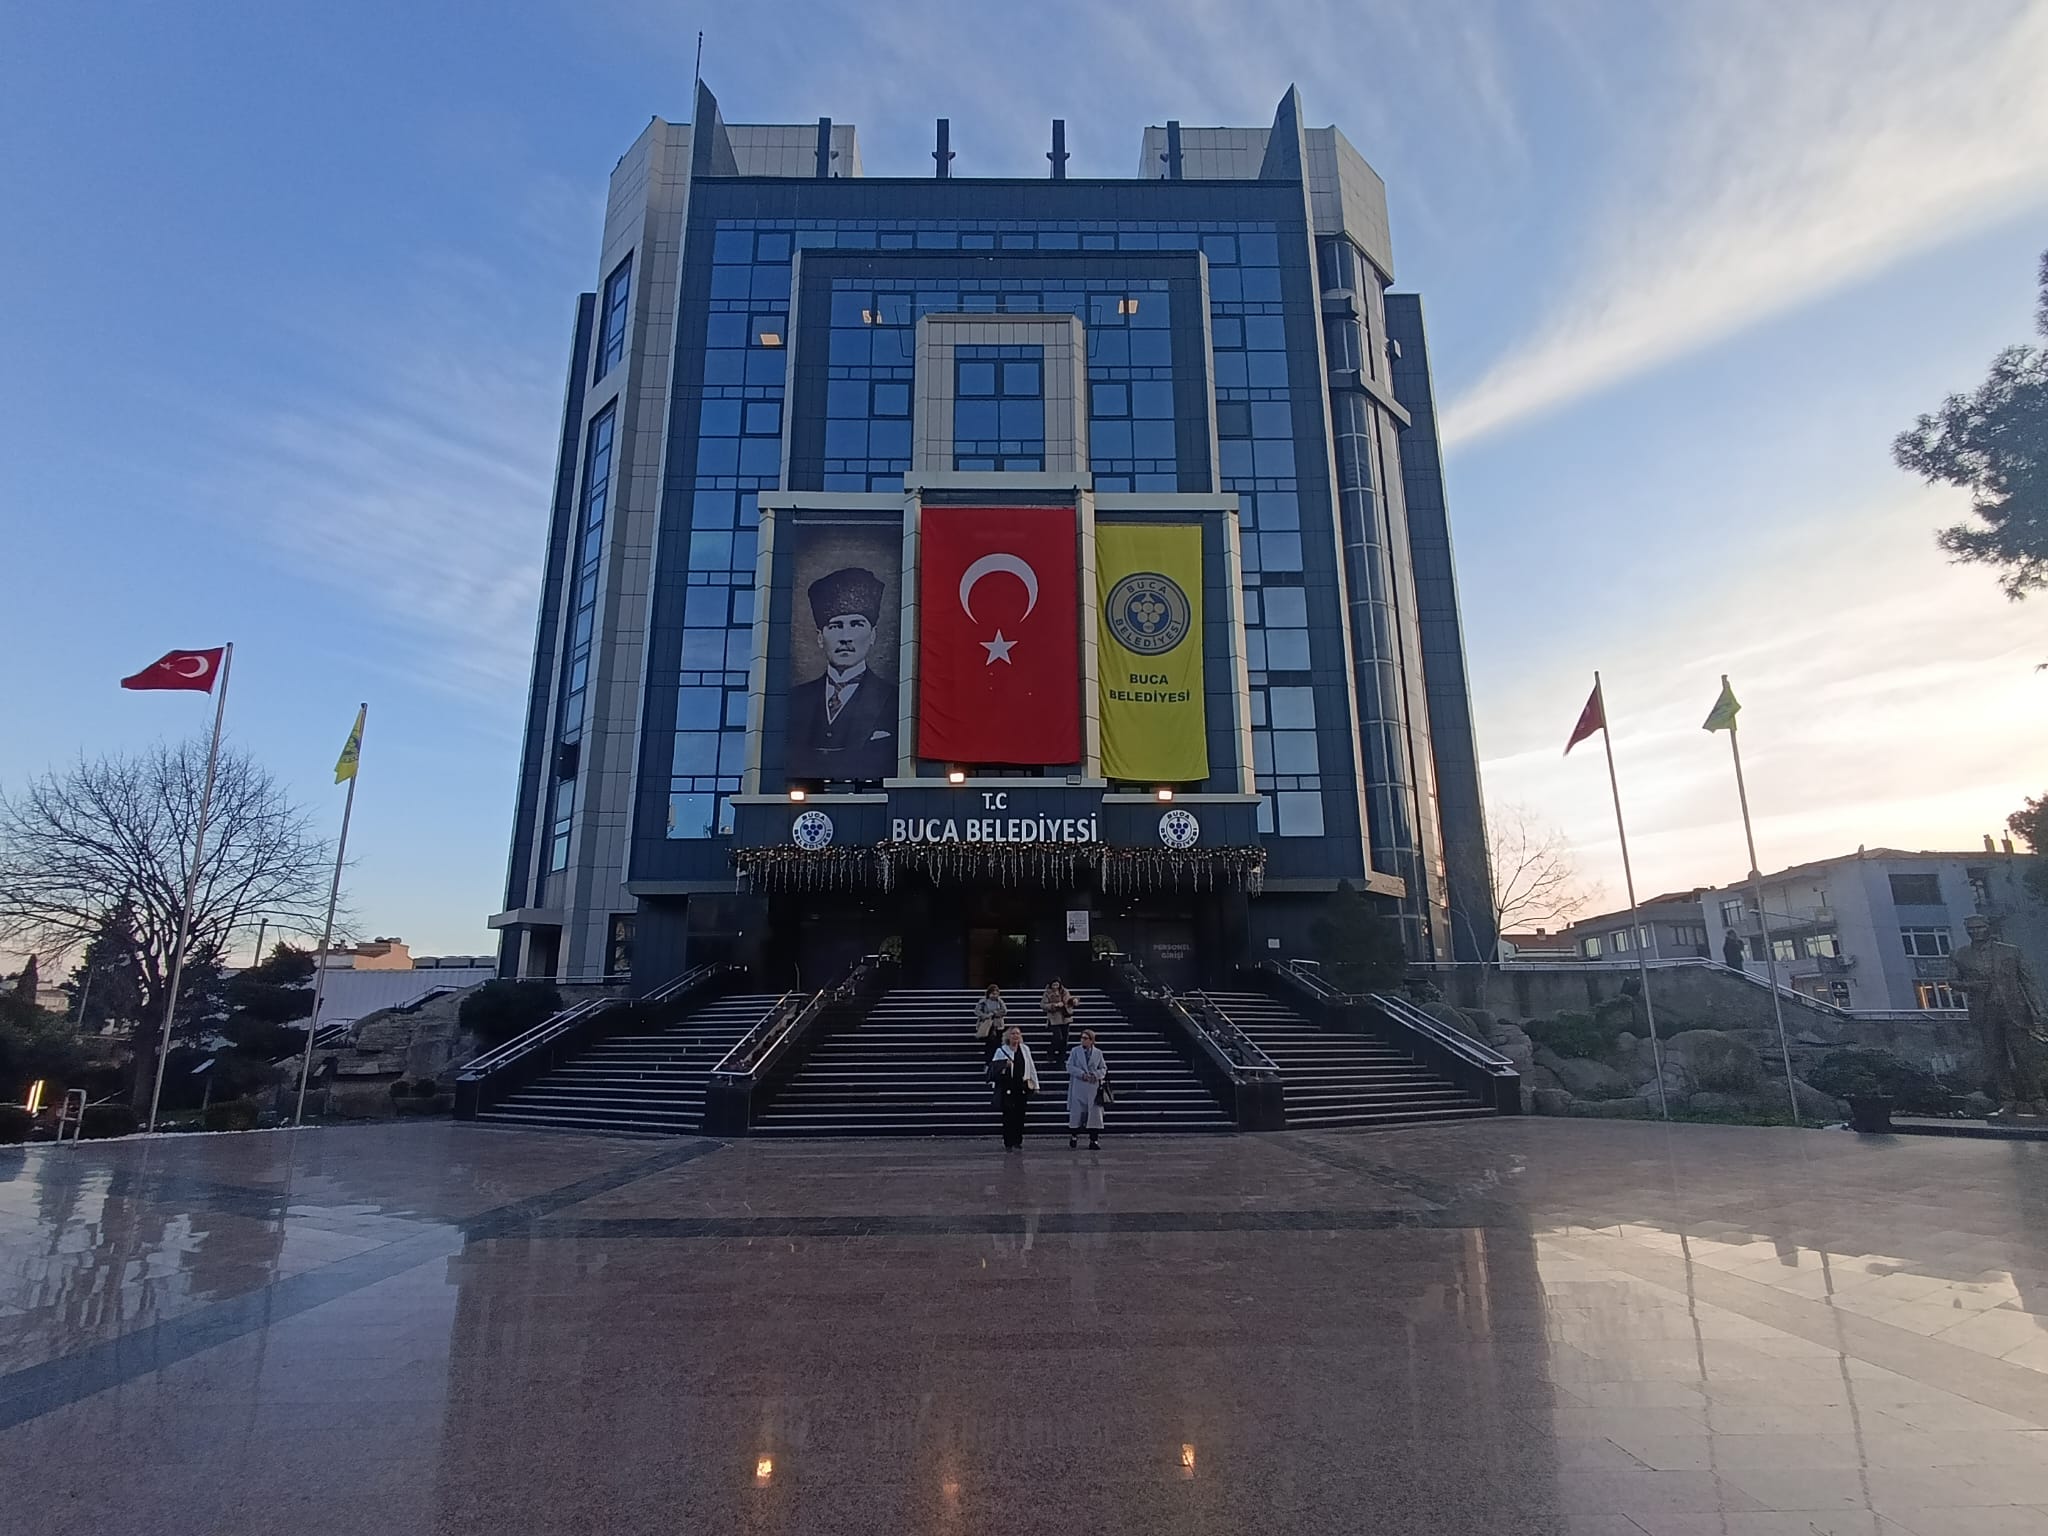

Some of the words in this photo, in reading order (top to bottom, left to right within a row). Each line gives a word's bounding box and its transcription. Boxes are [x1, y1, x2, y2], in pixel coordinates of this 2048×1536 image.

[1126, 581, 1167, 594] BUCA
[1115, 618, 1181, 647] BELEDİYESİ
[1129, 674, 1169, 685] BUCA
[1109, 688, 1190, 703] BELEDİYESİ
[981, 792, 1008, 810] T.C
[802, 812, 825, 821] BUCA
[1167, 811, 1190, 820] BUCA
[892, 818, 960, 842] BUCA
[966, 812, 1097, 843] BELEDİYESİ
